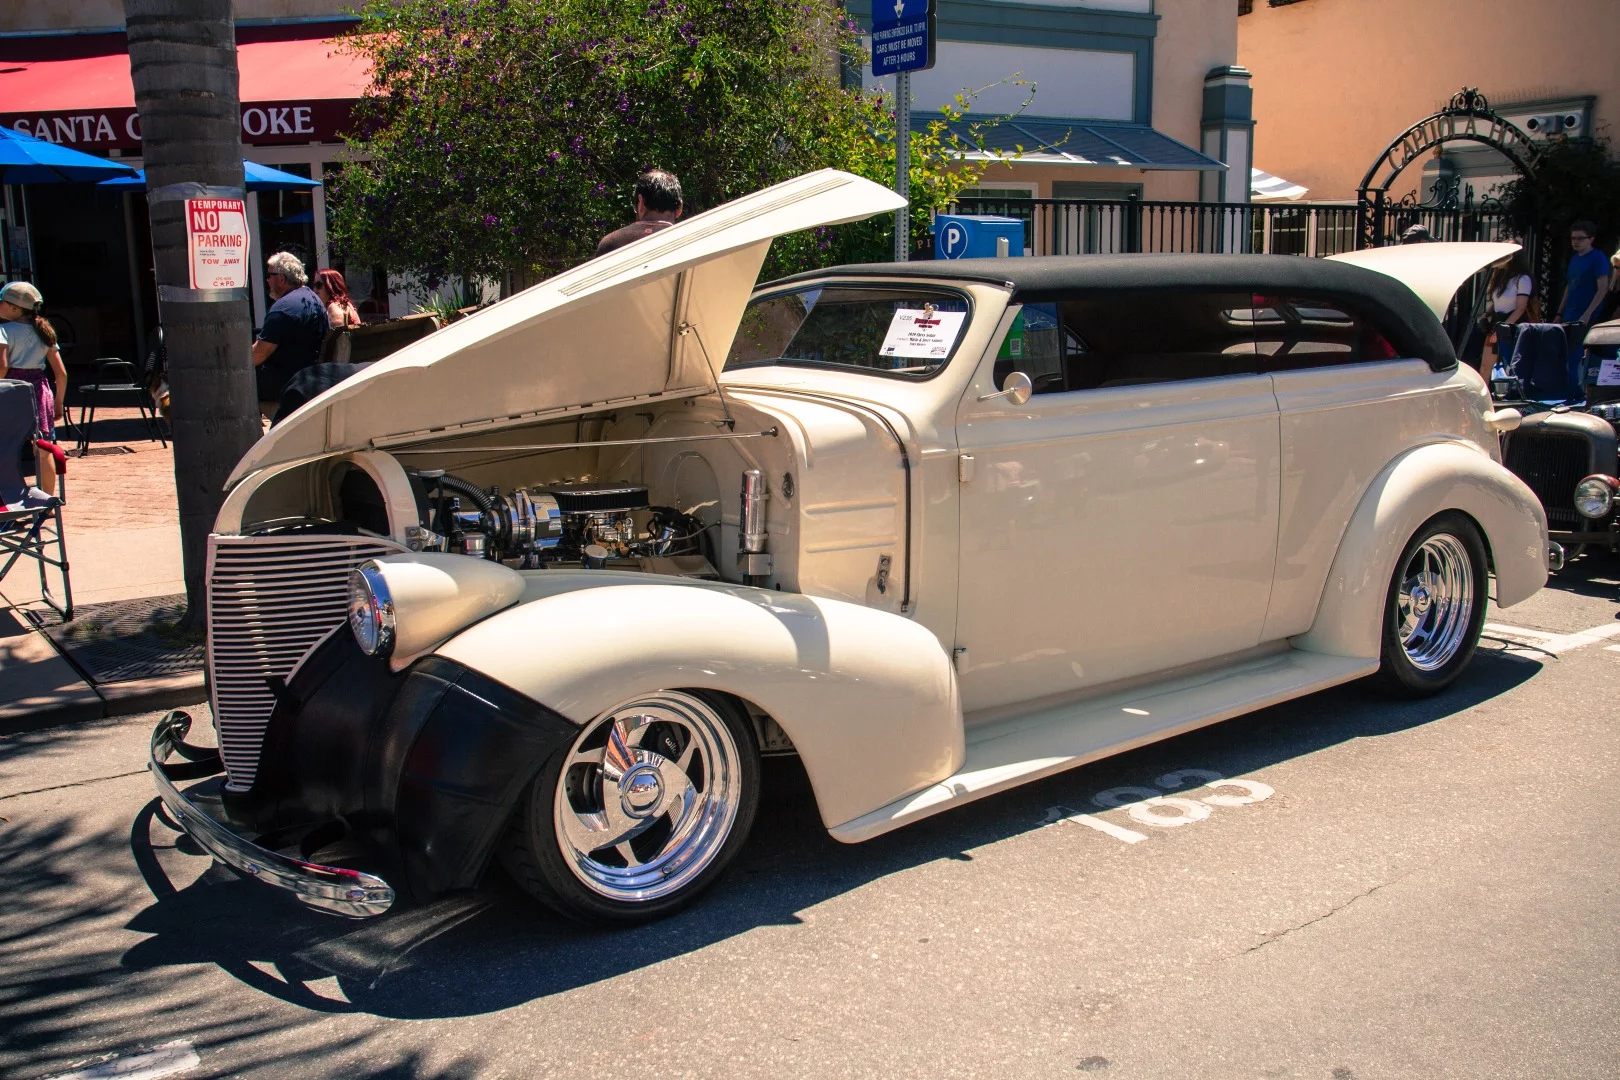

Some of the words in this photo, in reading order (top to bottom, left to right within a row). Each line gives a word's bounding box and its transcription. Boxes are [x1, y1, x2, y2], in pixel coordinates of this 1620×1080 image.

[876, 44, 888, 54] CARS
[888, 41, 900, 51] MUST
[901, 40, 907, 49] BE
[907, 37, 922, 48] MOVED
[883, 55, 896, 66] AFTER
[901, 52, 915, 63] HOURS
[13, 113, 117, 143] SANTA
[242, 106, 315, 135] OKE
[1388, 113, 1478, 171] CAPITOLA
[192, 200, 241, 209] TEMPORARY
[194, 211, 218, 230] NO
[197, 234, 242, 247] PARKING
[948, 228, 960, 254] P
[1037, 768, 1276, 845] 183
